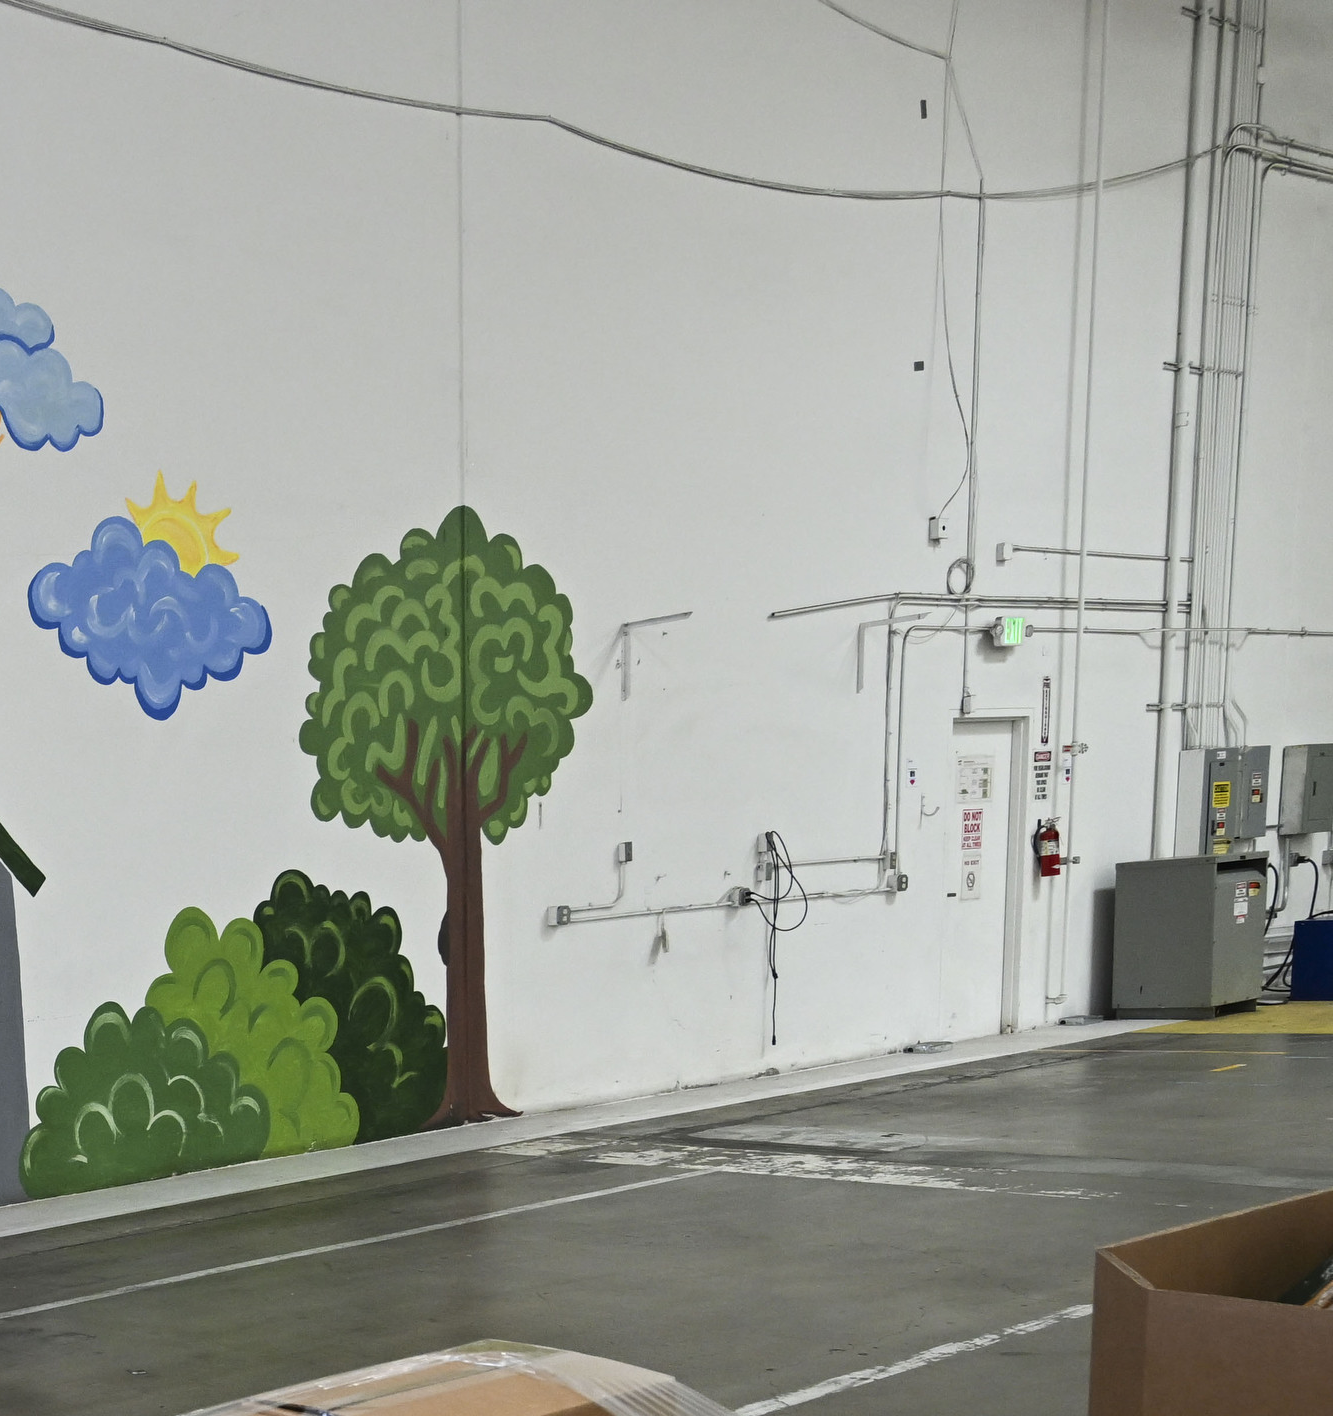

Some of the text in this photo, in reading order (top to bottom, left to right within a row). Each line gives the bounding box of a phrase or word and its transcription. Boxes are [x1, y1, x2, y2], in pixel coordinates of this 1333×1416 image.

[963, 811, 982, 821] DO NOT
[964, 823, 981, 833] BLOCK
